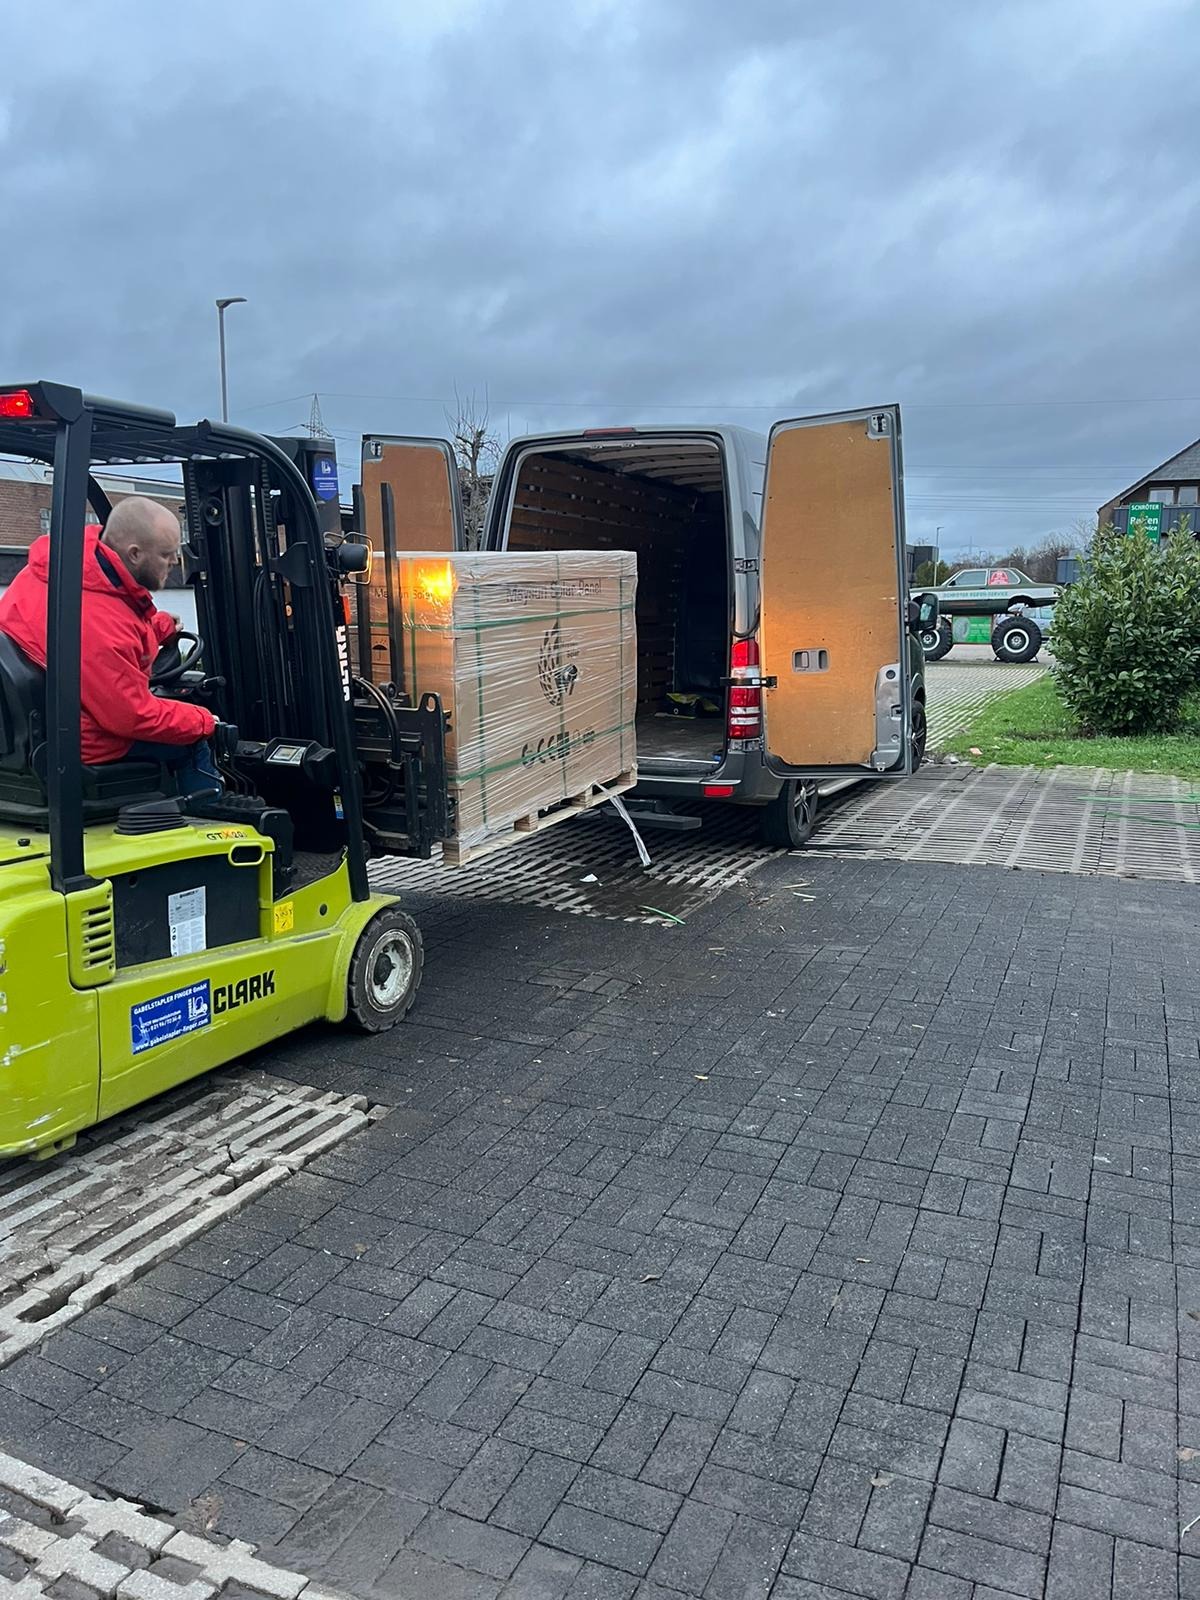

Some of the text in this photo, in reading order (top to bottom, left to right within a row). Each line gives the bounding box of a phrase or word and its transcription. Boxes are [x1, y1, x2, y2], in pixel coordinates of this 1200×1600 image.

[133, 983, 208, 1015] GABELSTAPLER FINGER GmbH
[213, 969, 275, 1015] CLARK
